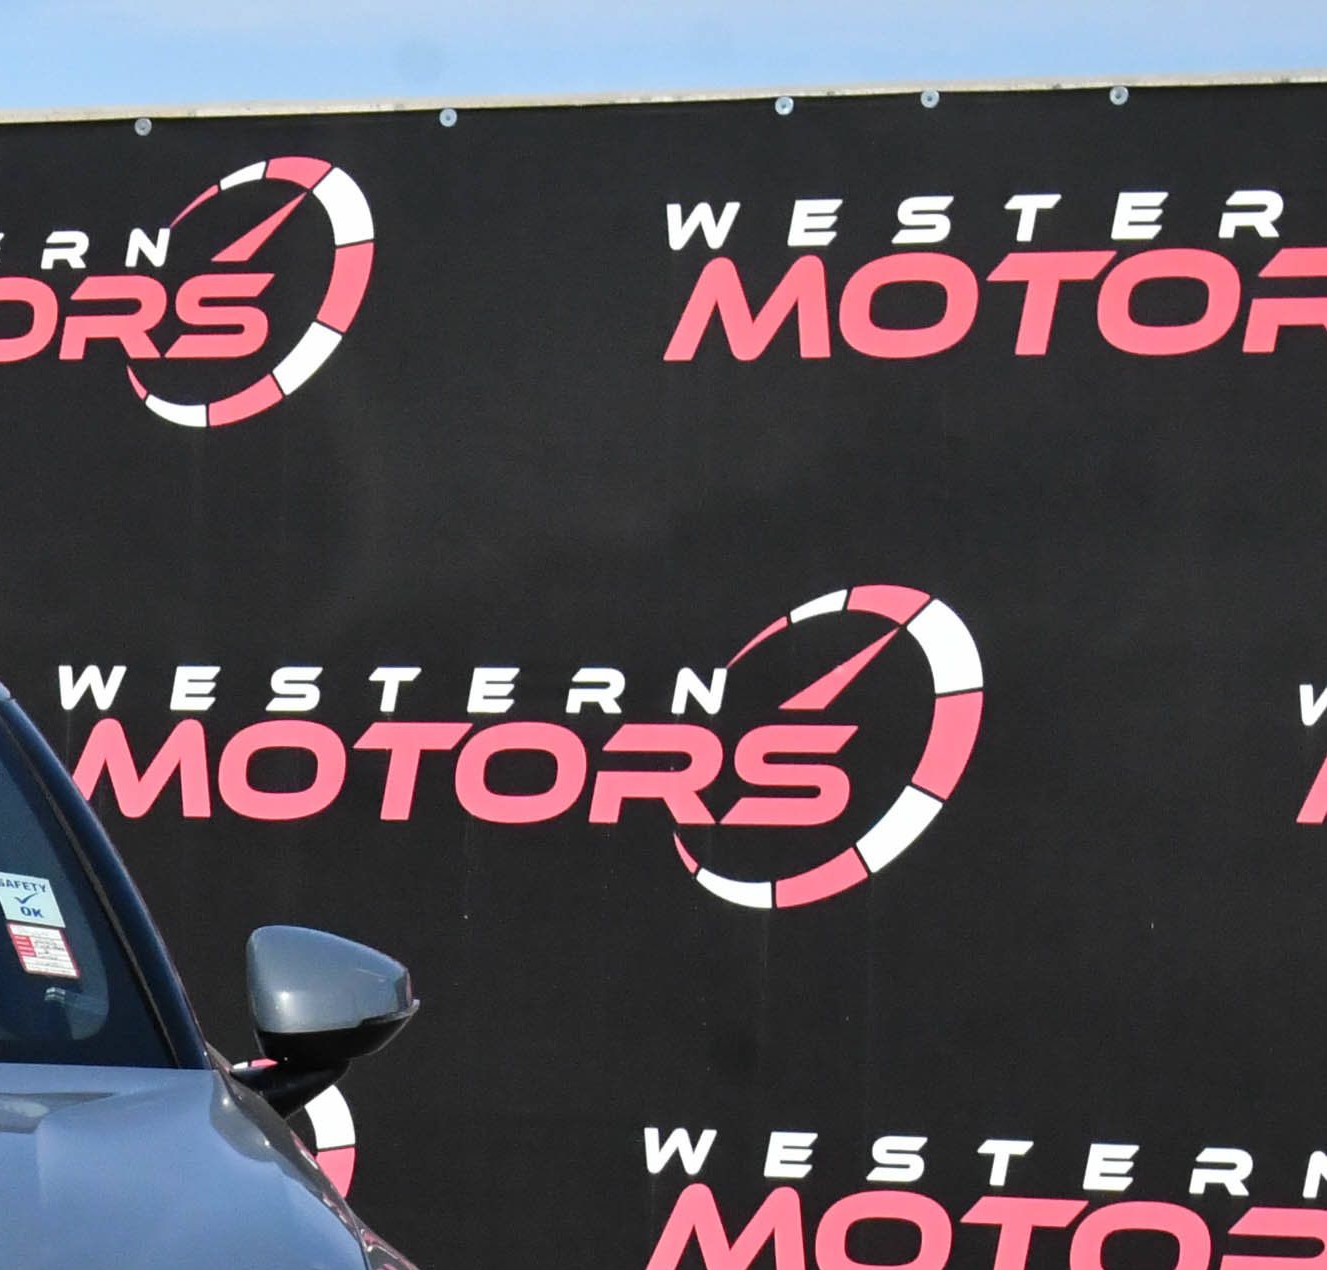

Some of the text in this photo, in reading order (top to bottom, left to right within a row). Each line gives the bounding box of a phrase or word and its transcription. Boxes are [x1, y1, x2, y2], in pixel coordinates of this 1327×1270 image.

[58, 664, 728, 715] WESTERN
[72, 717, 859, 827] MOTORS
[20, 906, 45, 918] OK
